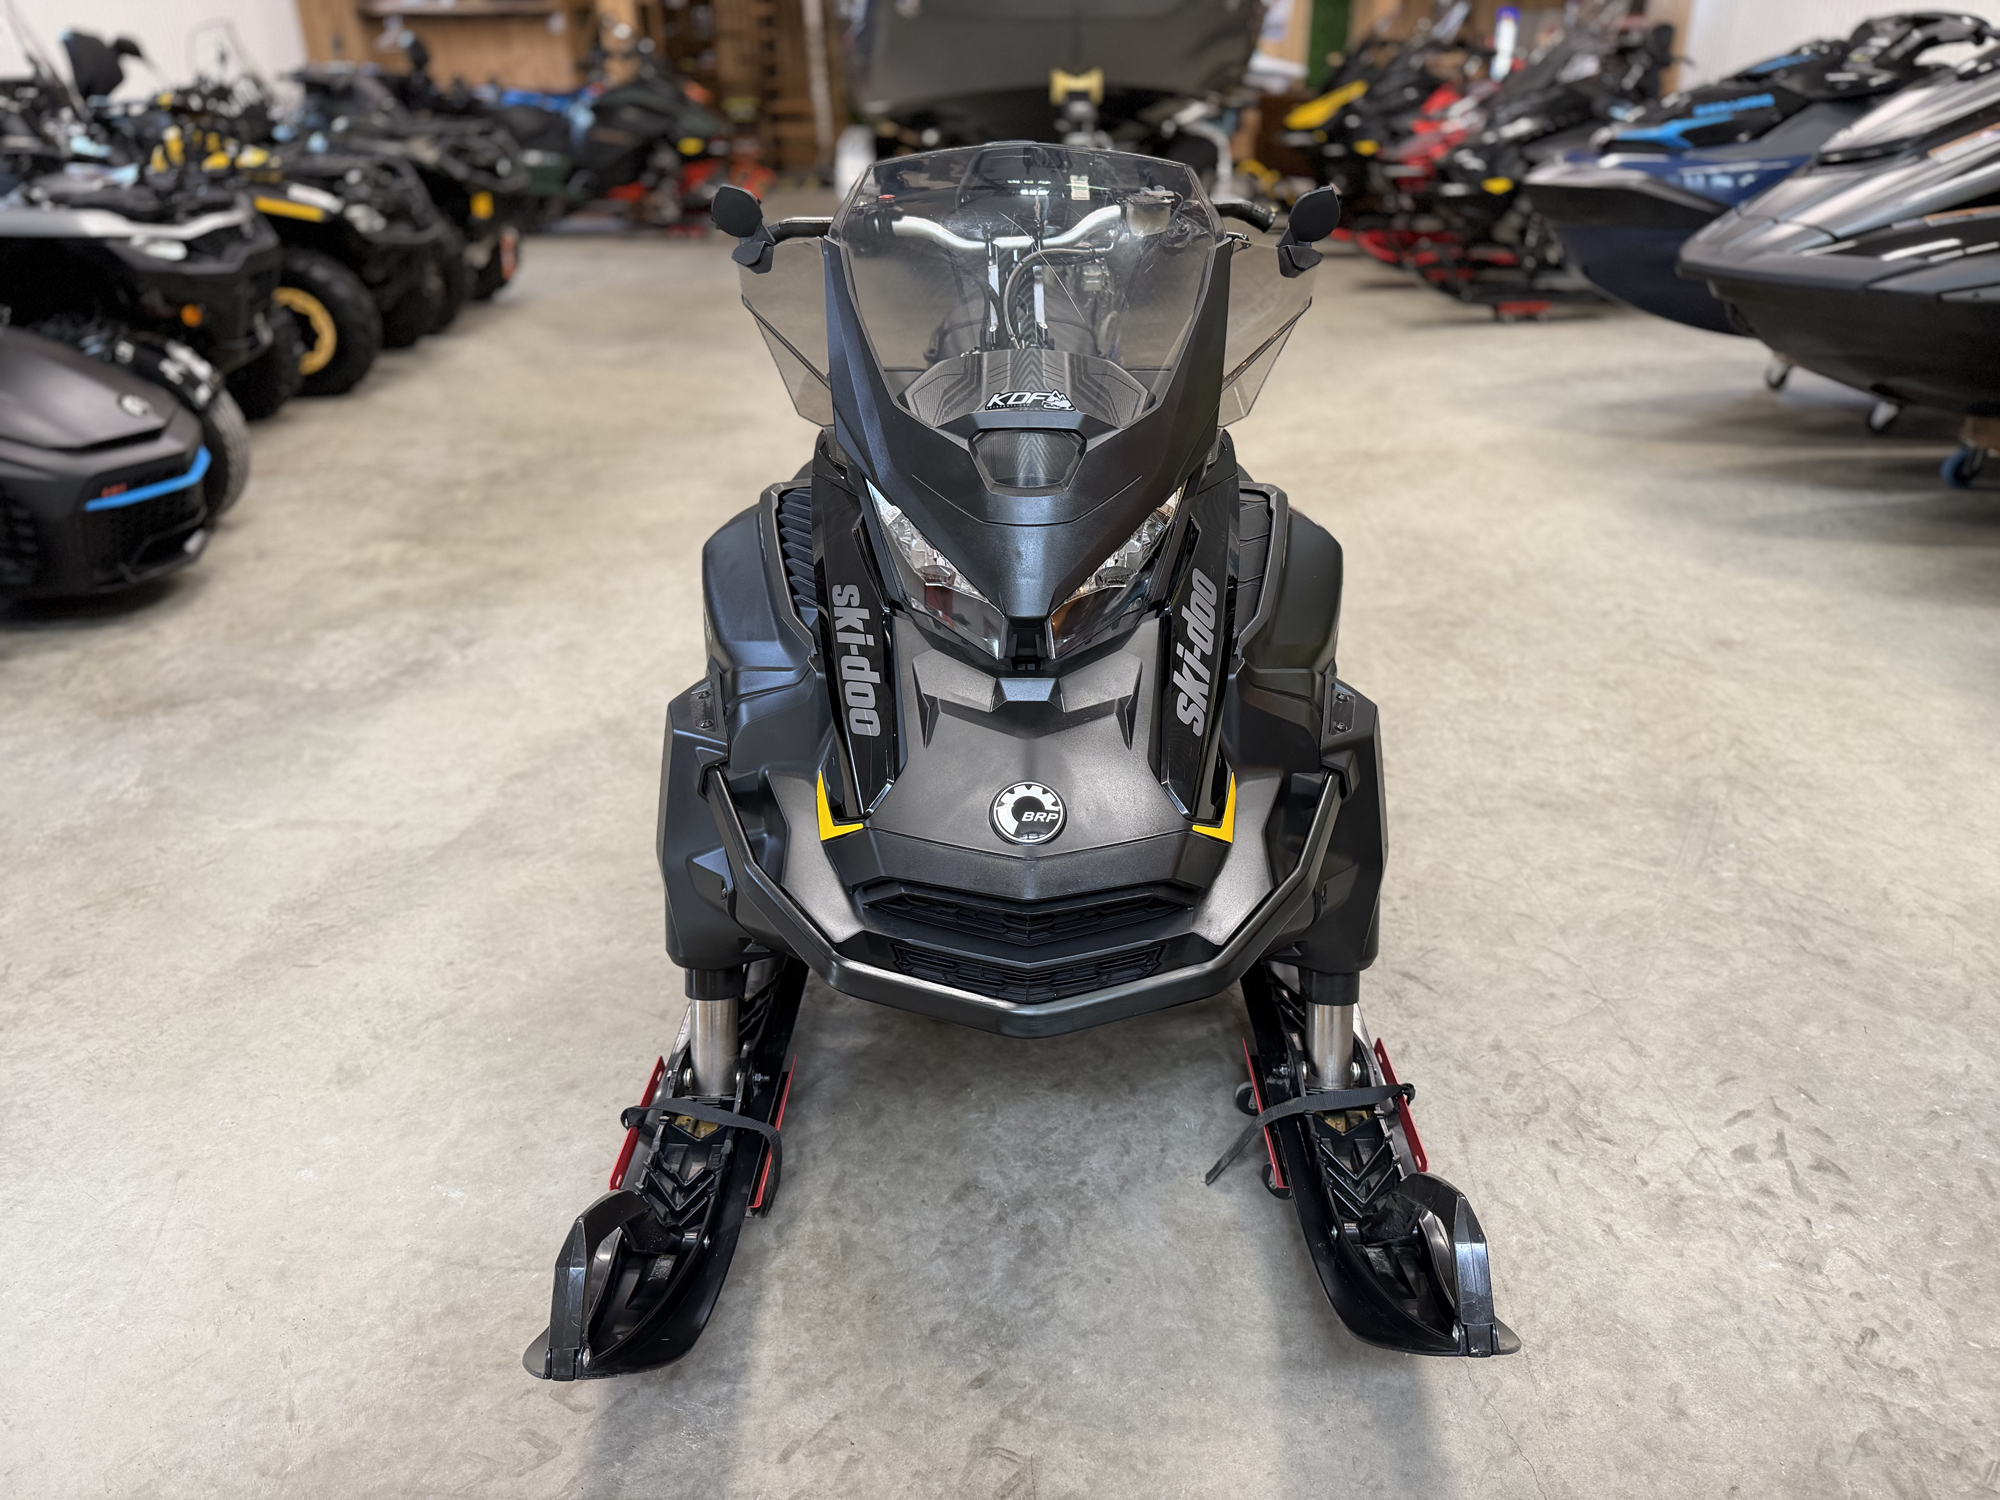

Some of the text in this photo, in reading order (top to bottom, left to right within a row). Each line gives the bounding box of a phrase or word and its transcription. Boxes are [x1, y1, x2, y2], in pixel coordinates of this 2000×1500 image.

[986, 391, 1053, 407] KDF
[831, 584, 881, 737] ski-doo
[1172, 567, 1217, 737] ski-doo
[1021, 811, 1059, 823] BRP
